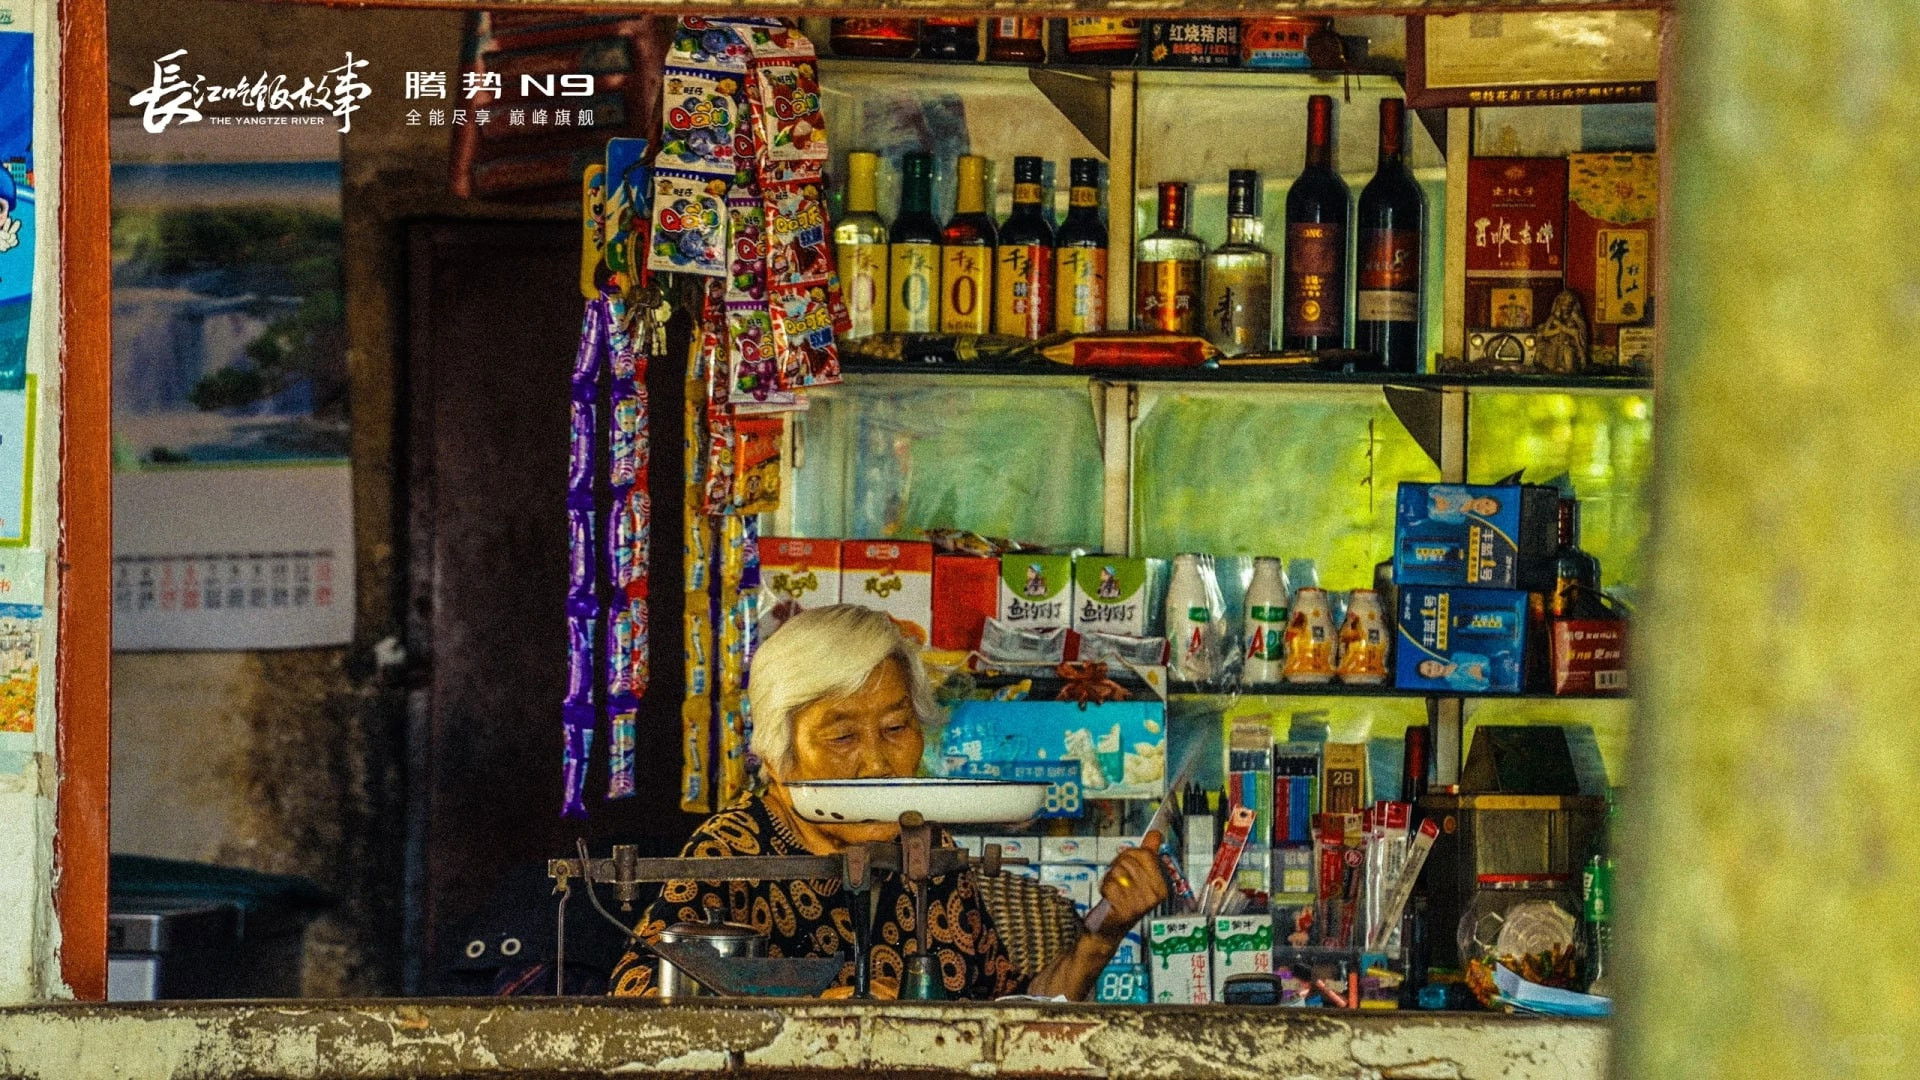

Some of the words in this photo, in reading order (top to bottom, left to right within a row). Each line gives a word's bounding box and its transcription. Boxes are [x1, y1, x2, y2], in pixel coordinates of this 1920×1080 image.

[951, 251, 981, 275] 千禾
[952, 275, 977, 316] 0
[1333, 771, 1353, 785] 2B
